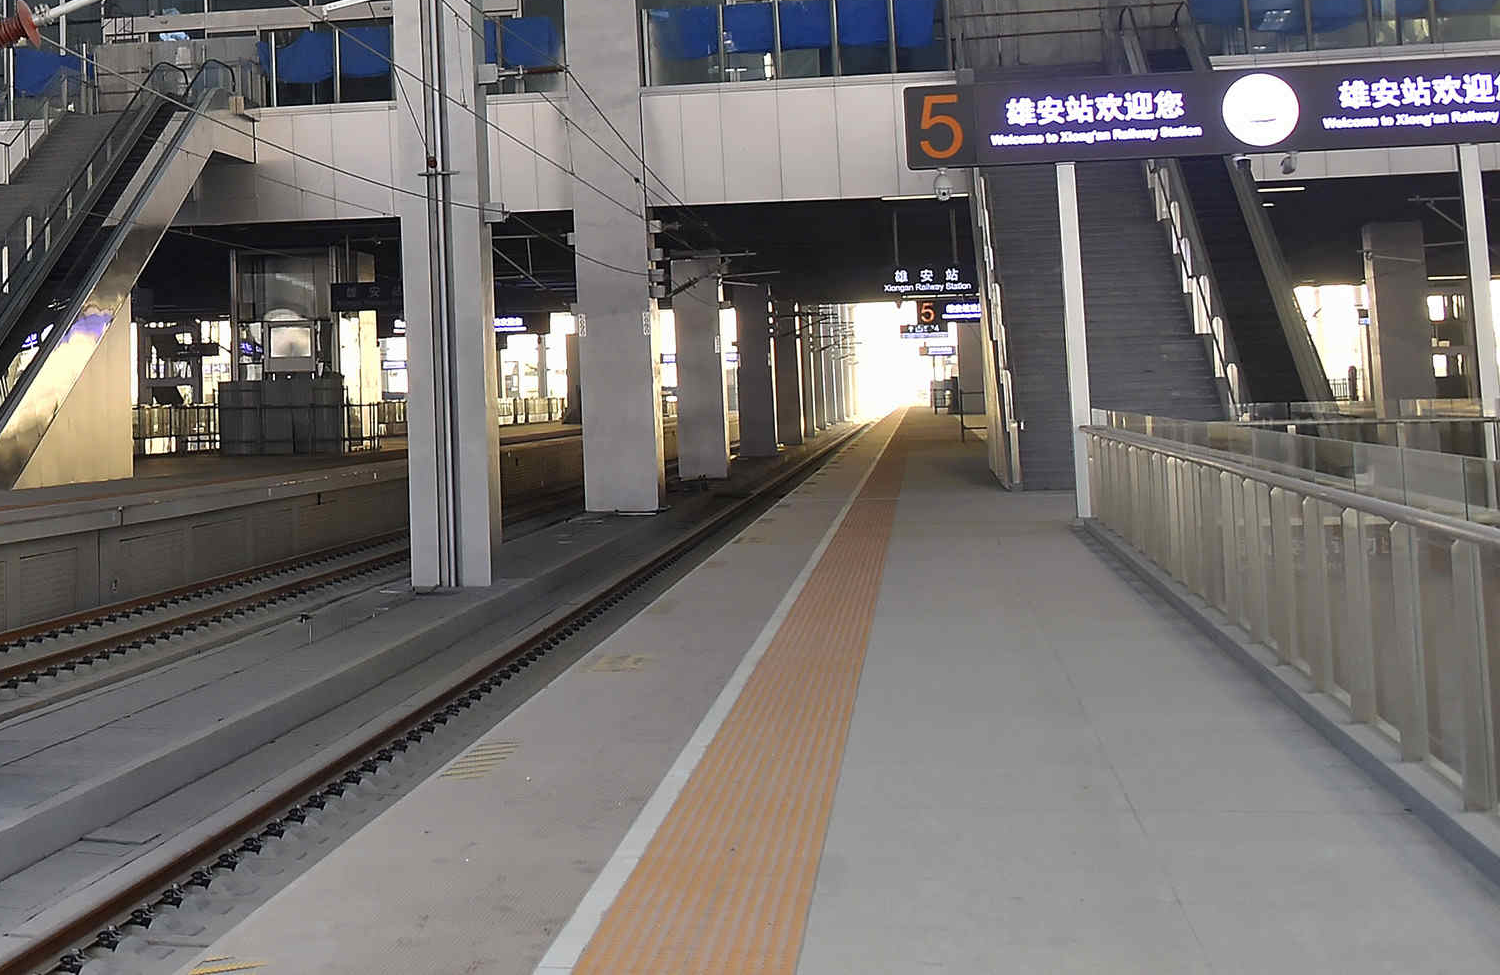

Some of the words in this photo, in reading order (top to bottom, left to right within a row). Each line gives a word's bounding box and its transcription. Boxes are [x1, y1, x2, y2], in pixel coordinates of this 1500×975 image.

[1338, 73, 1500, 110] 雄安站欢迎
[1005, 90, 1185, 127] 雄安站欢迎您
[1322, 116, 1380, 129] Welcome
[1380, 115, 1395, 127] to
[1450, 110, 1500, 124] Railway
[919, 93, 964, 159] 5
[990, 133, 1045, 146] Welcome
[1045, 132, 1059, 144] to
[1112, 127, 1159, 141] Railway
[1159, 125, 1203, 138] Station
[921, 302, 936, 323] 5
